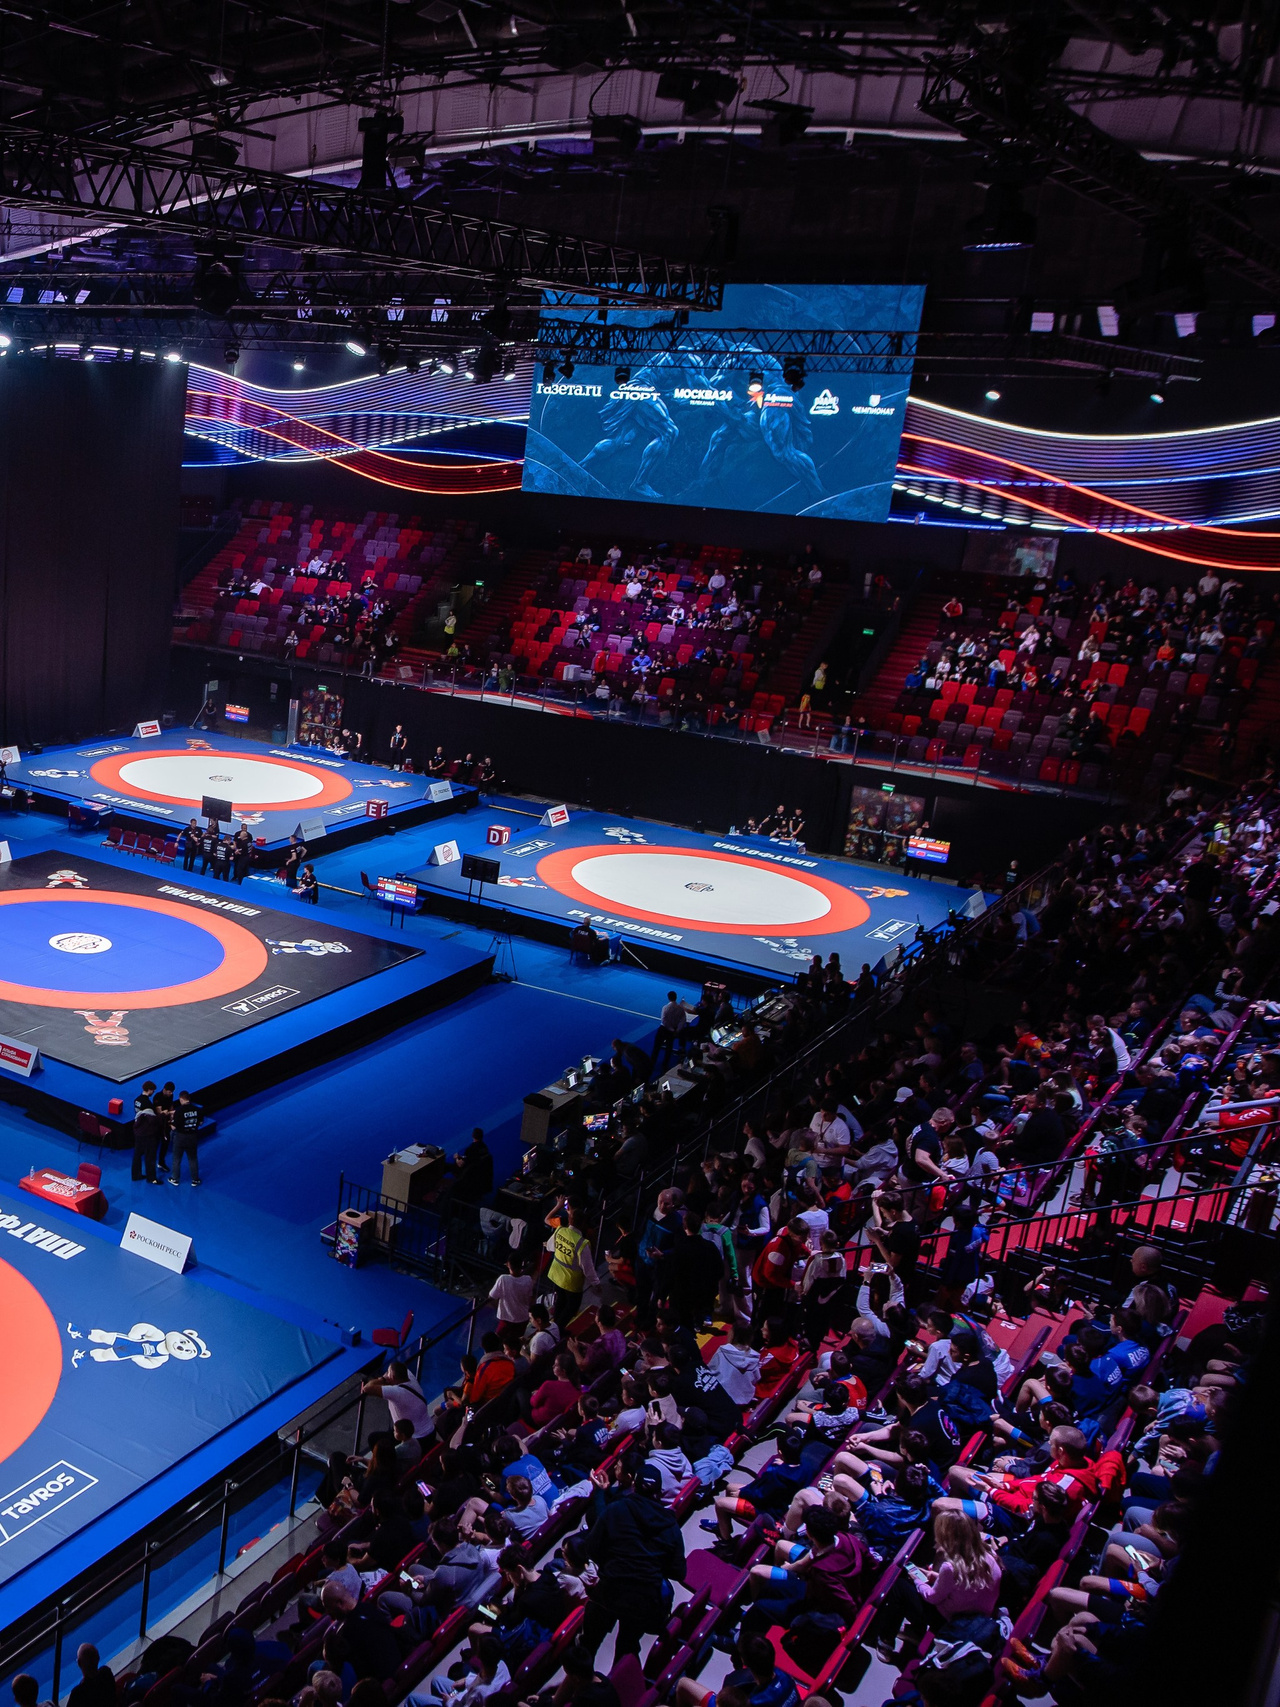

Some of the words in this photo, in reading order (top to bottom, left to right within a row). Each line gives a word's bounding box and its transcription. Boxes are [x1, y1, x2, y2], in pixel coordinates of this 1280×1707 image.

[609, 391, 661, 401] СПОРТ
[852, 406, 895, 416] ЧЕМПИОНАТ
[91, 793, 174, 815] PLATFORMA
[368, 804, 377, 817] E
[381, 804, 387, 817] E
[489, 830, 500, 844] D
[157, 885, 261, 917] ПЛАТФОРМА
[566, 909, 684, 942] PLATFORMA
[136, 1233, 182, 1258] РОСКОНГРЕСС
